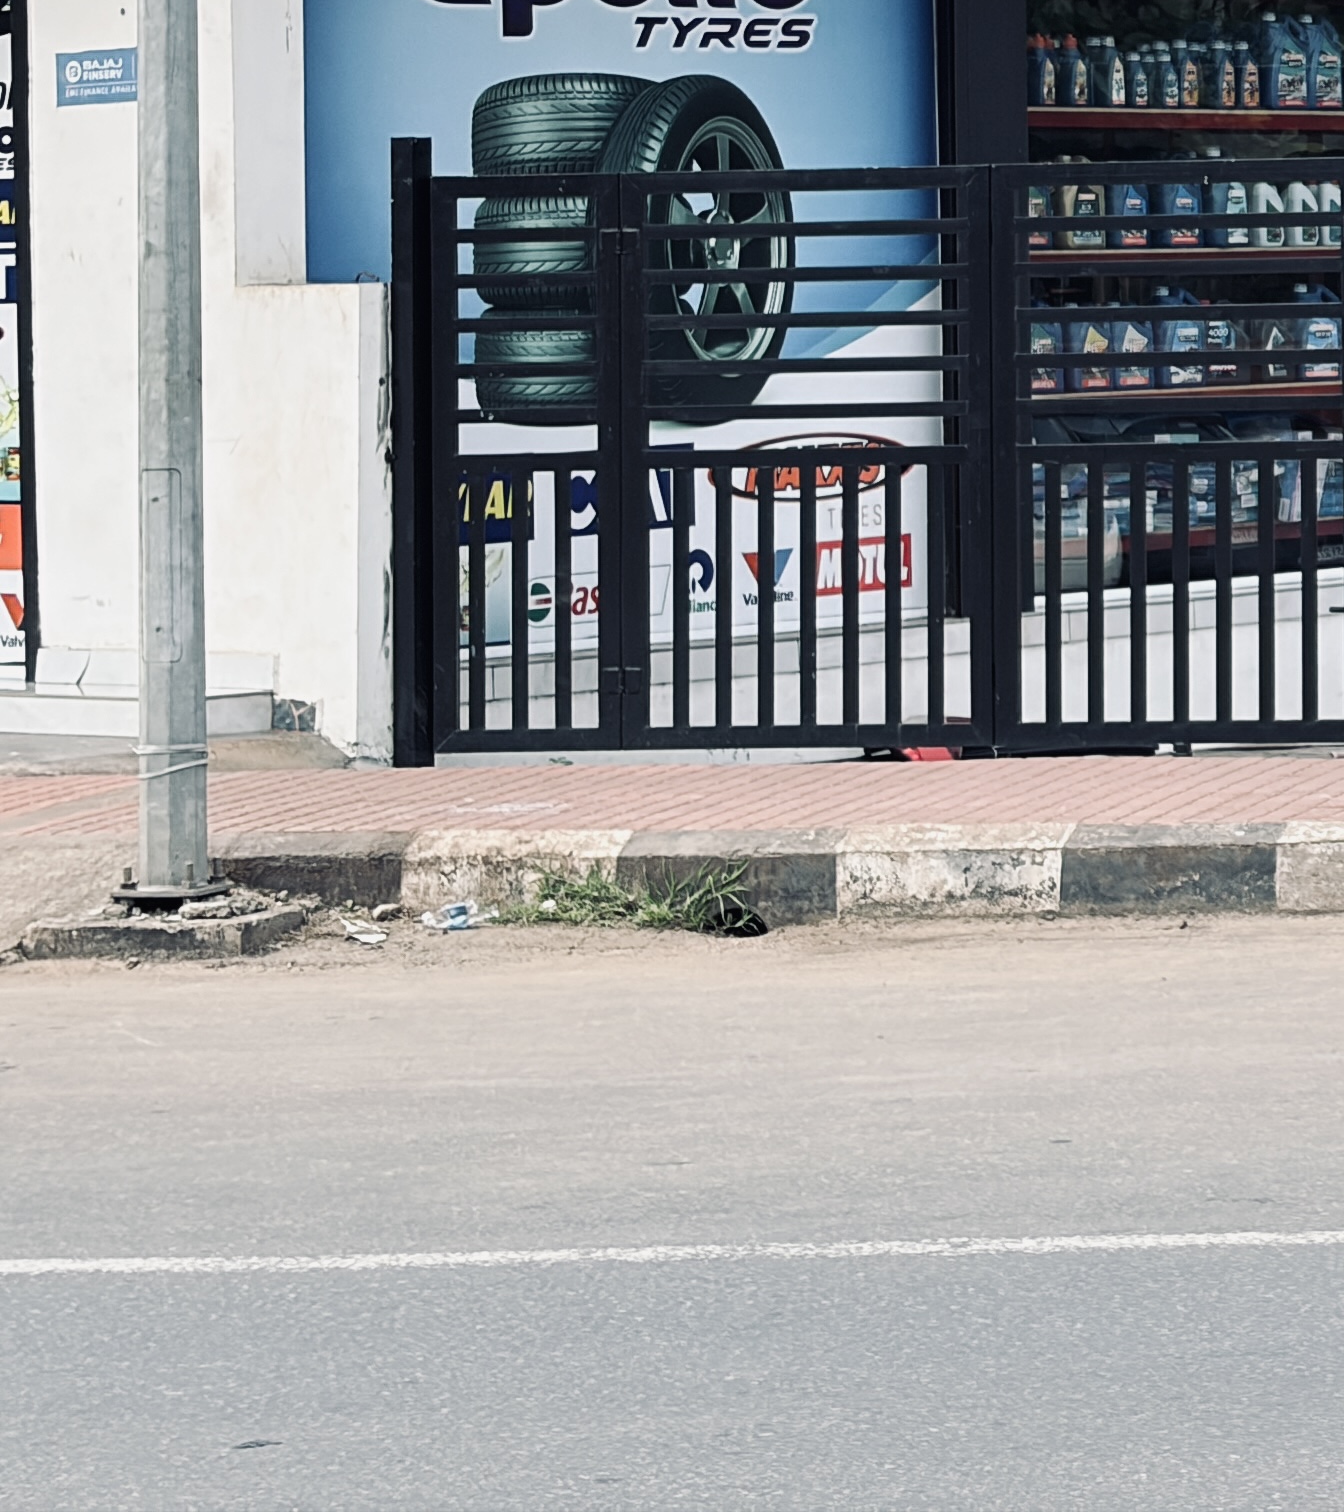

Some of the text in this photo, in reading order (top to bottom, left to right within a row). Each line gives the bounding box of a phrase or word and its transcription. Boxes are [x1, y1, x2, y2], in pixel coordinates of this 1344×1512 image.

[634, 16, 815, 49] TYRES
[82, 58, 123, 70] BAJAJ
[82, 69, 123, 80] FINSERV
[828, 504, 882, 529] TES
